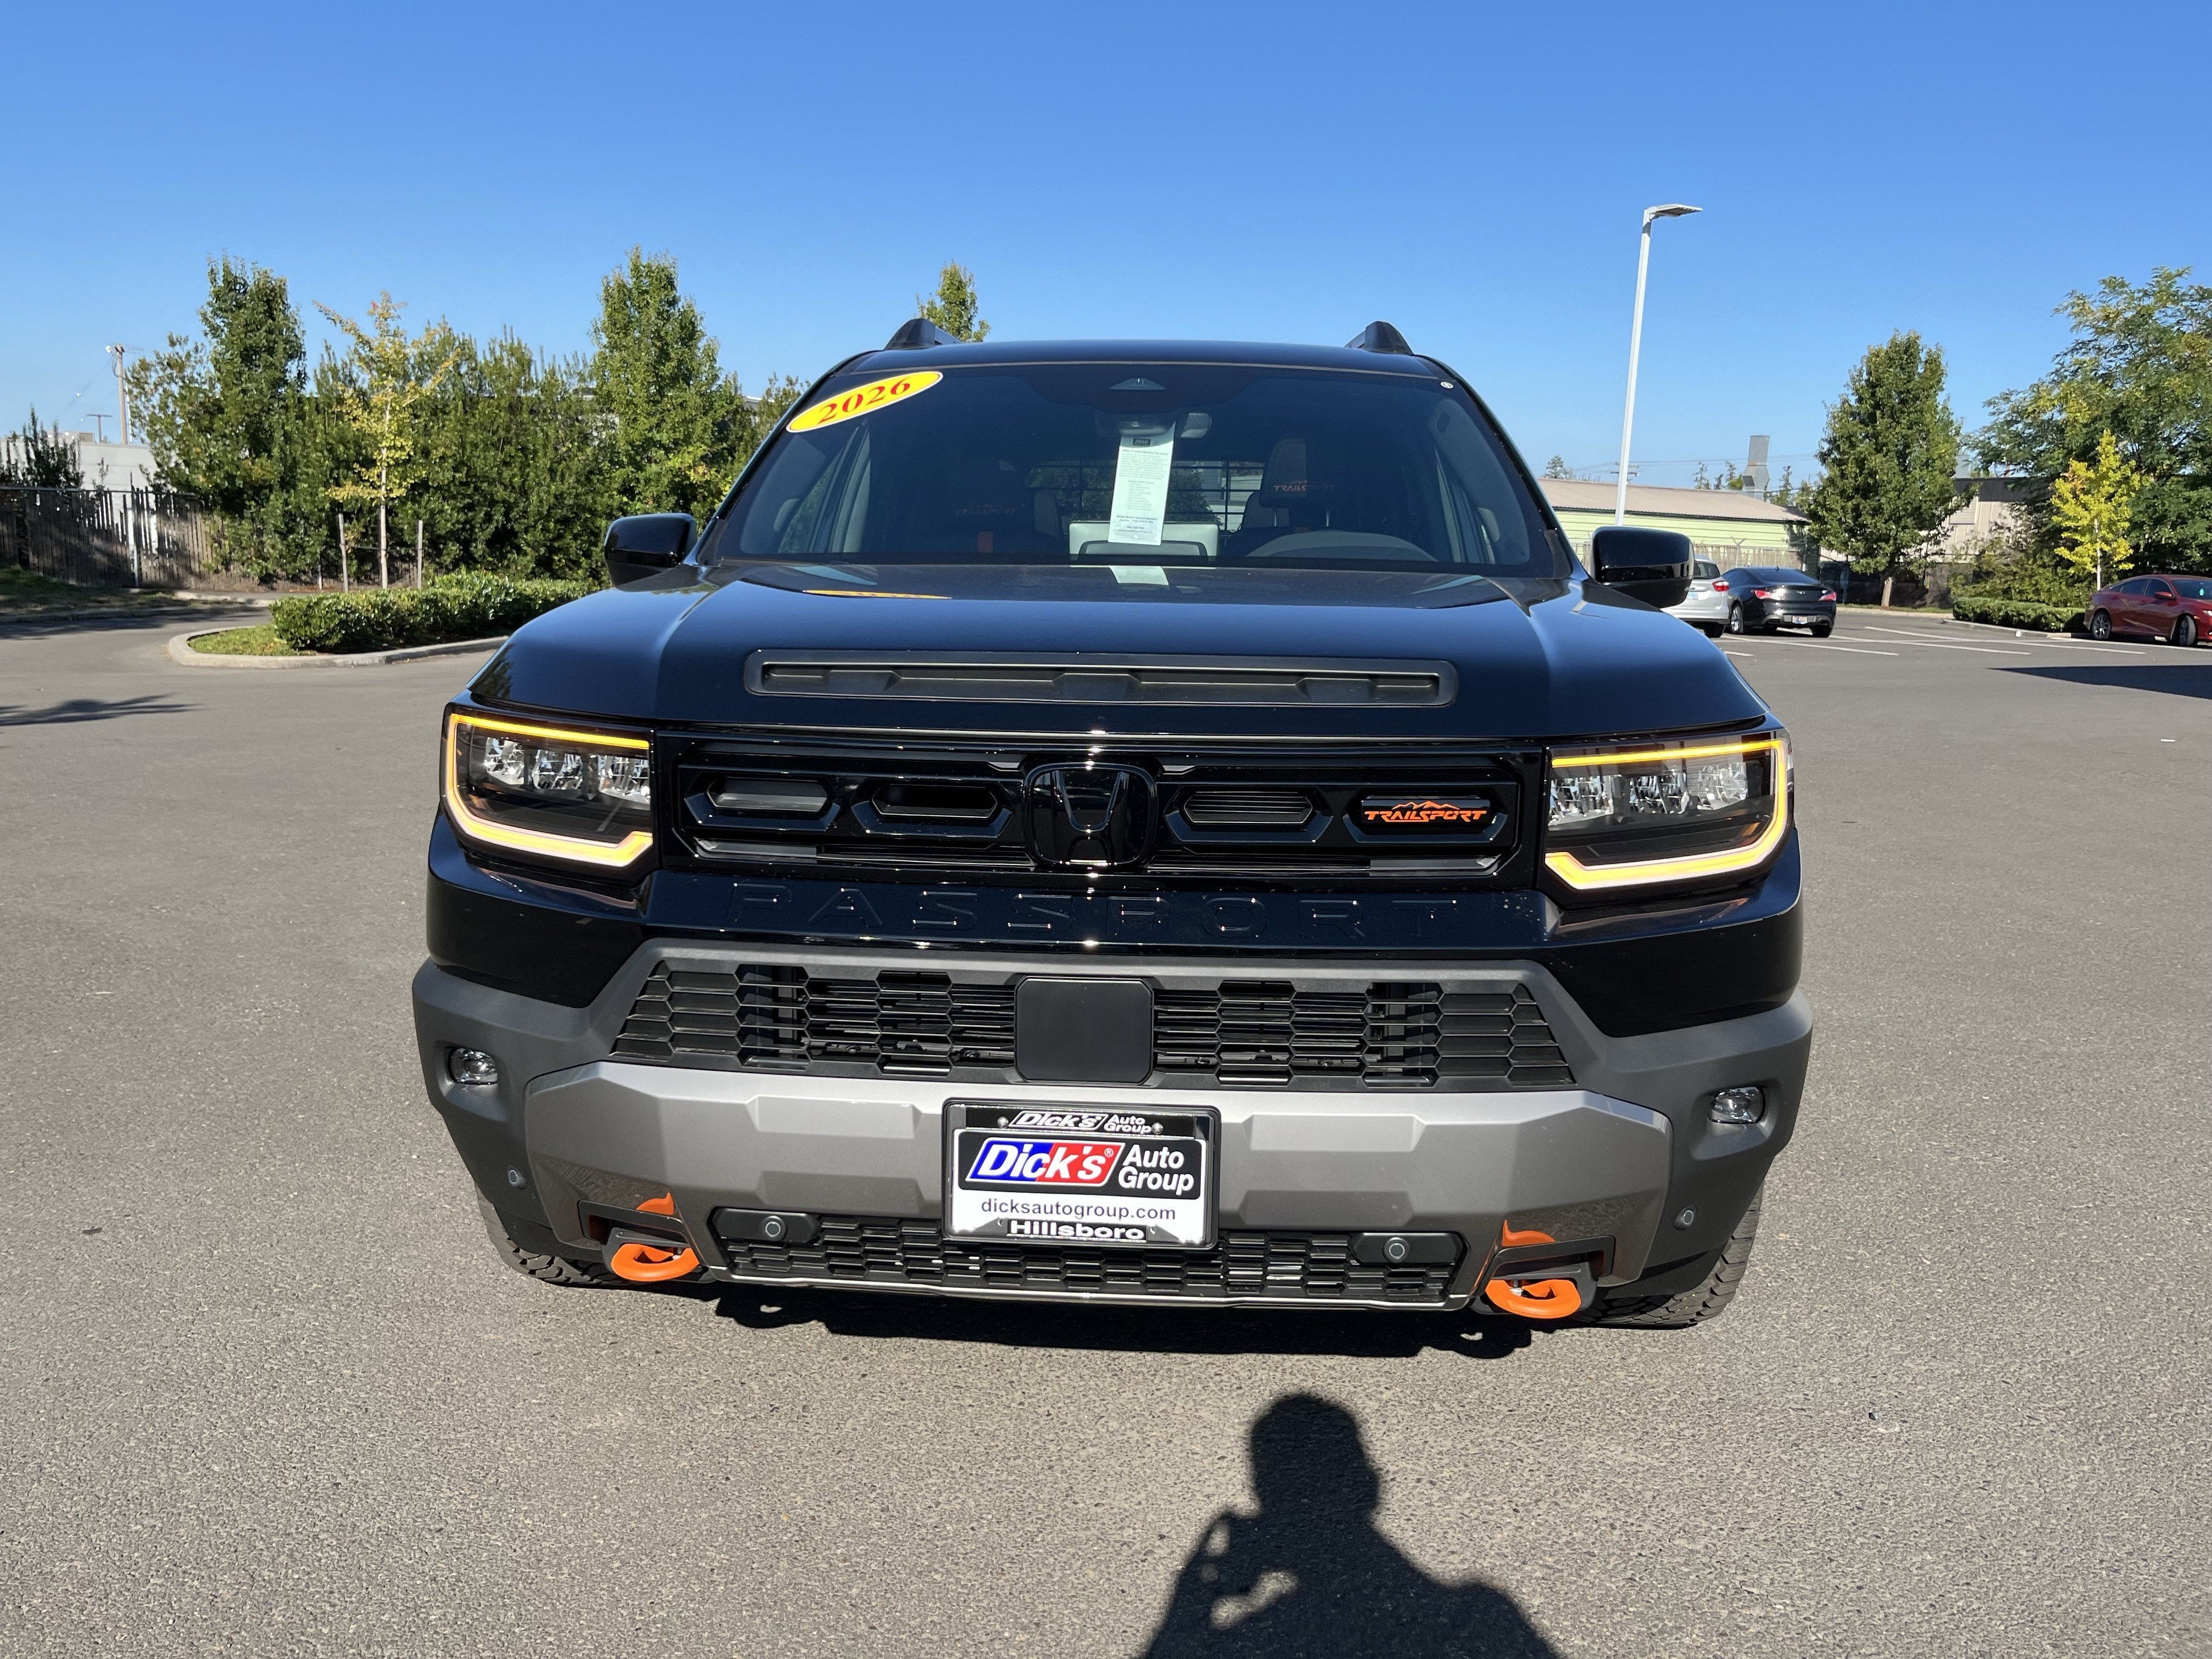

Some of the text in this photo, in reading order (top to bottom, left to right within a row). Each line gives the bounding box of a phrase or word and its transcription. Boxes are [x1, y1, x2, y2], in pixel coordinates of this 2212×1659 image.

[817, 376, 912, 425] 2026
[1364, 810, 1487, 822] TRAILSPORT
[726, 882, 1457, 939] PASSPORT
[1016, 1113, 1146, 1128] Dick's Auto
[1104, 1123, 1152, 1134] Group
[1122, 1144, 1184, 1169] Auto
[1118, 1169, 1194, 1195] Group
[981, 1198, 1176, 1220] dicksautogroup.com
[1011, 1221, 1144, 1240] Hillsboro
